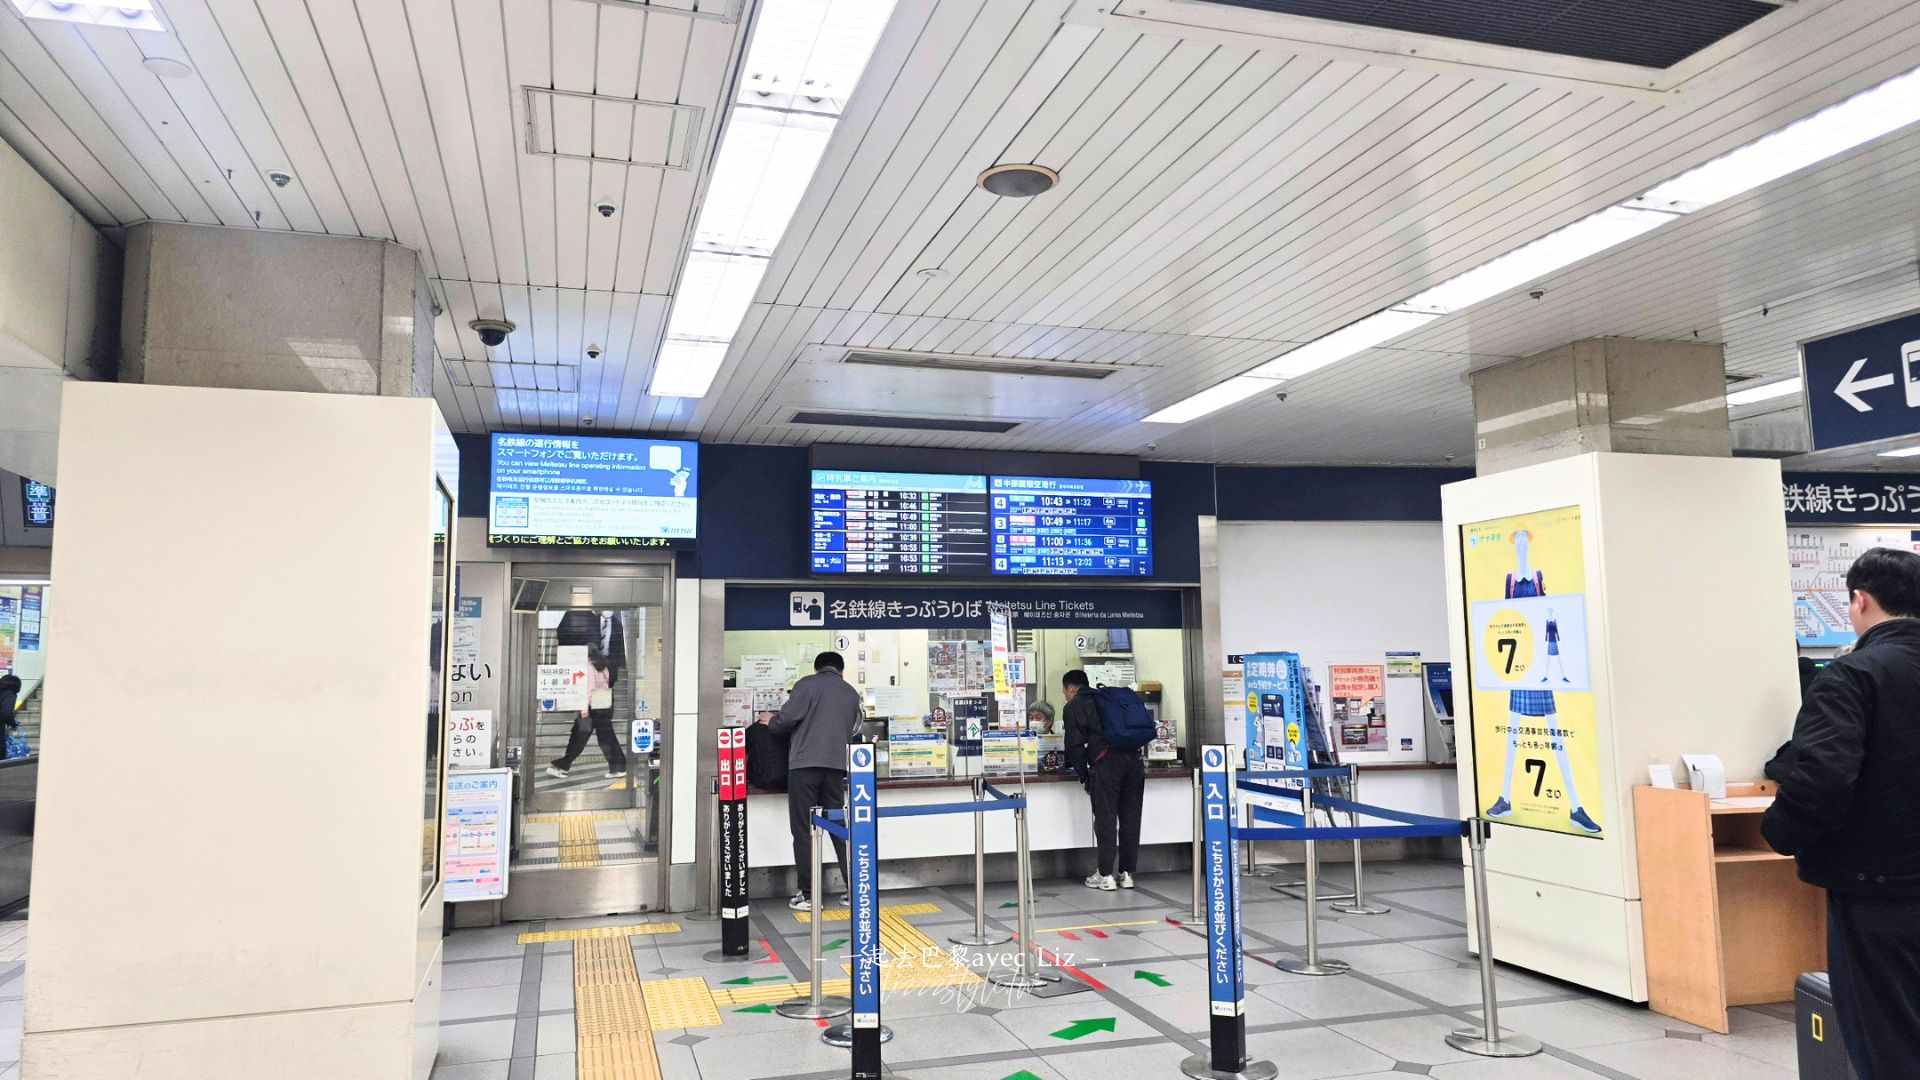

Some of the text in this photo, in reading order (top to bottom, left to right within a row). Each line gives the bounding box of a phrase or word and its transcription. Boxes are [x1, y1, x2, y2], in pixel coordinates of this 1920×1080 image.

[498, 438, 579, 449] 名鉄線の運行情報を
[497, 448, 638, 462] スマートフォンでご覧いただけます。
[581, 463, 611, 471] operating
[1041, 496, 1063, 506] 10:43
[1073, 498, 1091, 506] 11:32
[1041, 516, 1063, 526] 10:49
[1073, 518, 1091, 526] 11:17
[1042, 536, 1064, 546] 11:00
[1042, 556, 1064, 567] 11:13
[830, 600, 983, 619] 名鉄線きっぷうりば
[1035, 600, 1056, 610] Line
[1058, 600, 1094, 610] Tickets
[720, 759, 730, 786] 出口
[735, 757, 745, 785] 出口
[854, 784, 872, 823] 入口
[1206, 782, 1224, 820] 入口
[722, 805, 732, 897] ありがとうございました
[737, 803, 746, 896] ありがとうございました
[858, 844, 872, 995] こちらからお並びください
[1212, 841, 1229, 984] こちらからお並びください
